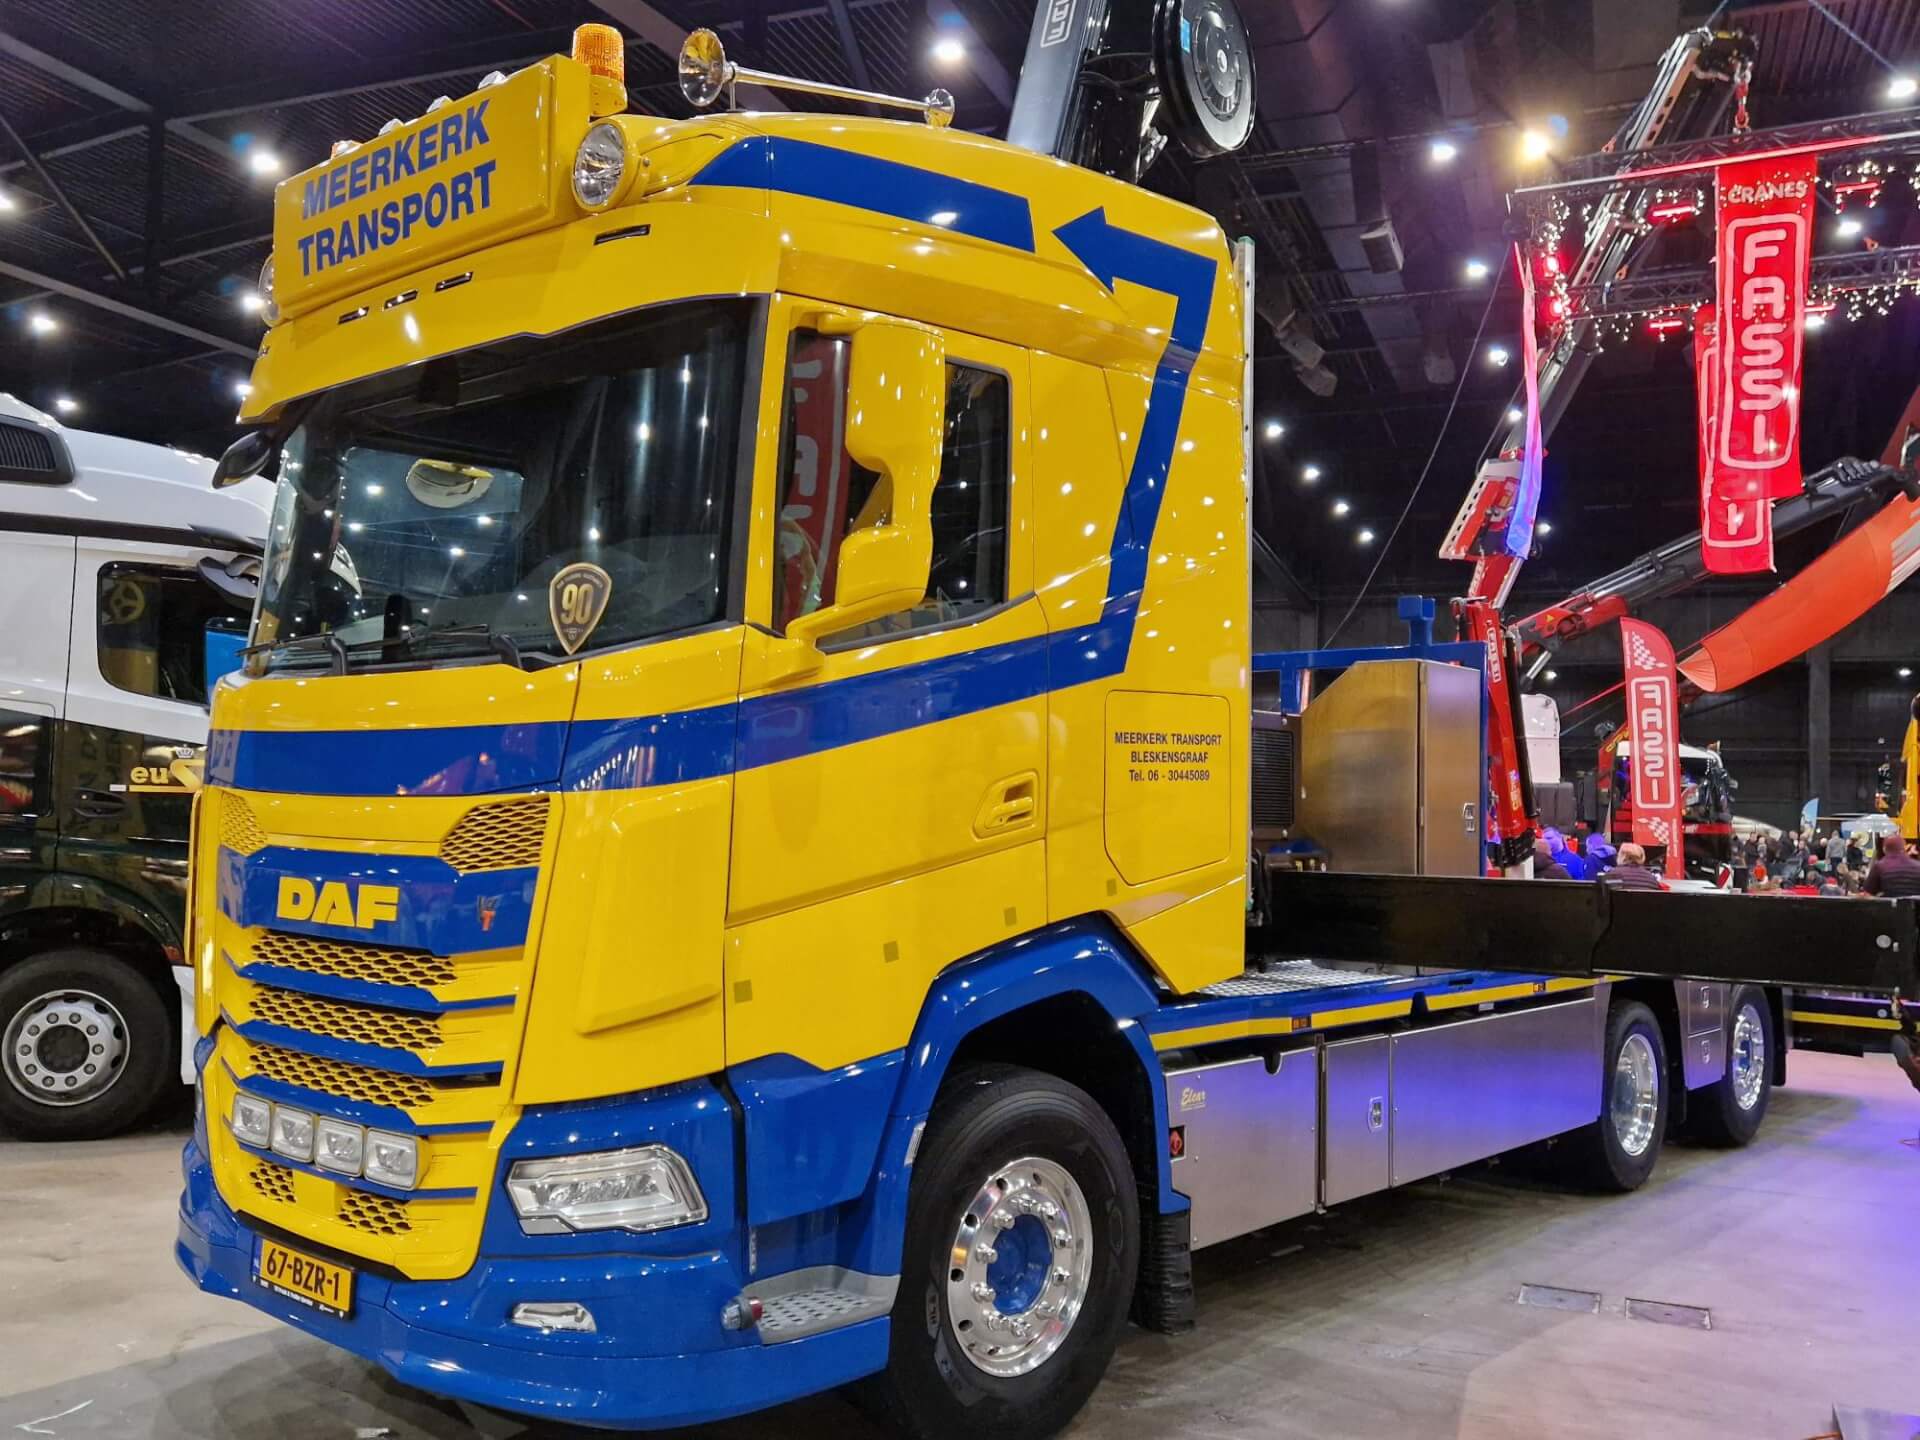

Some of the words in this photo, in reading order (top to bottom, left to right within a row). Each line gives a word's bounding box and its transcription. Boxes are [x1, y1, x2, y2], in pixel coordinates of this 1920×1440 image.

[303, 99, 490, 220] MEERKERK
[1727, 180, 1808, 204] CRANES
[297, 159, 497, 277] TRANSPORT
[1741, 228, 1787, 455] FASSI
[561, 583, 594, 624] 90
[1114, 732, 1168, 745] MEERKERK
[1171, 733, 1222, 746] TRANSPORT
[1130, 751, 1209, 763] BLESKENSGRAAF
[1129, 769, 1145, 782] Tel.
[1148, 769, 1159, 781] 06
[276, 876, 400, 930] DAF
[266, 1248, 340, 1302] 67-BZR-1
